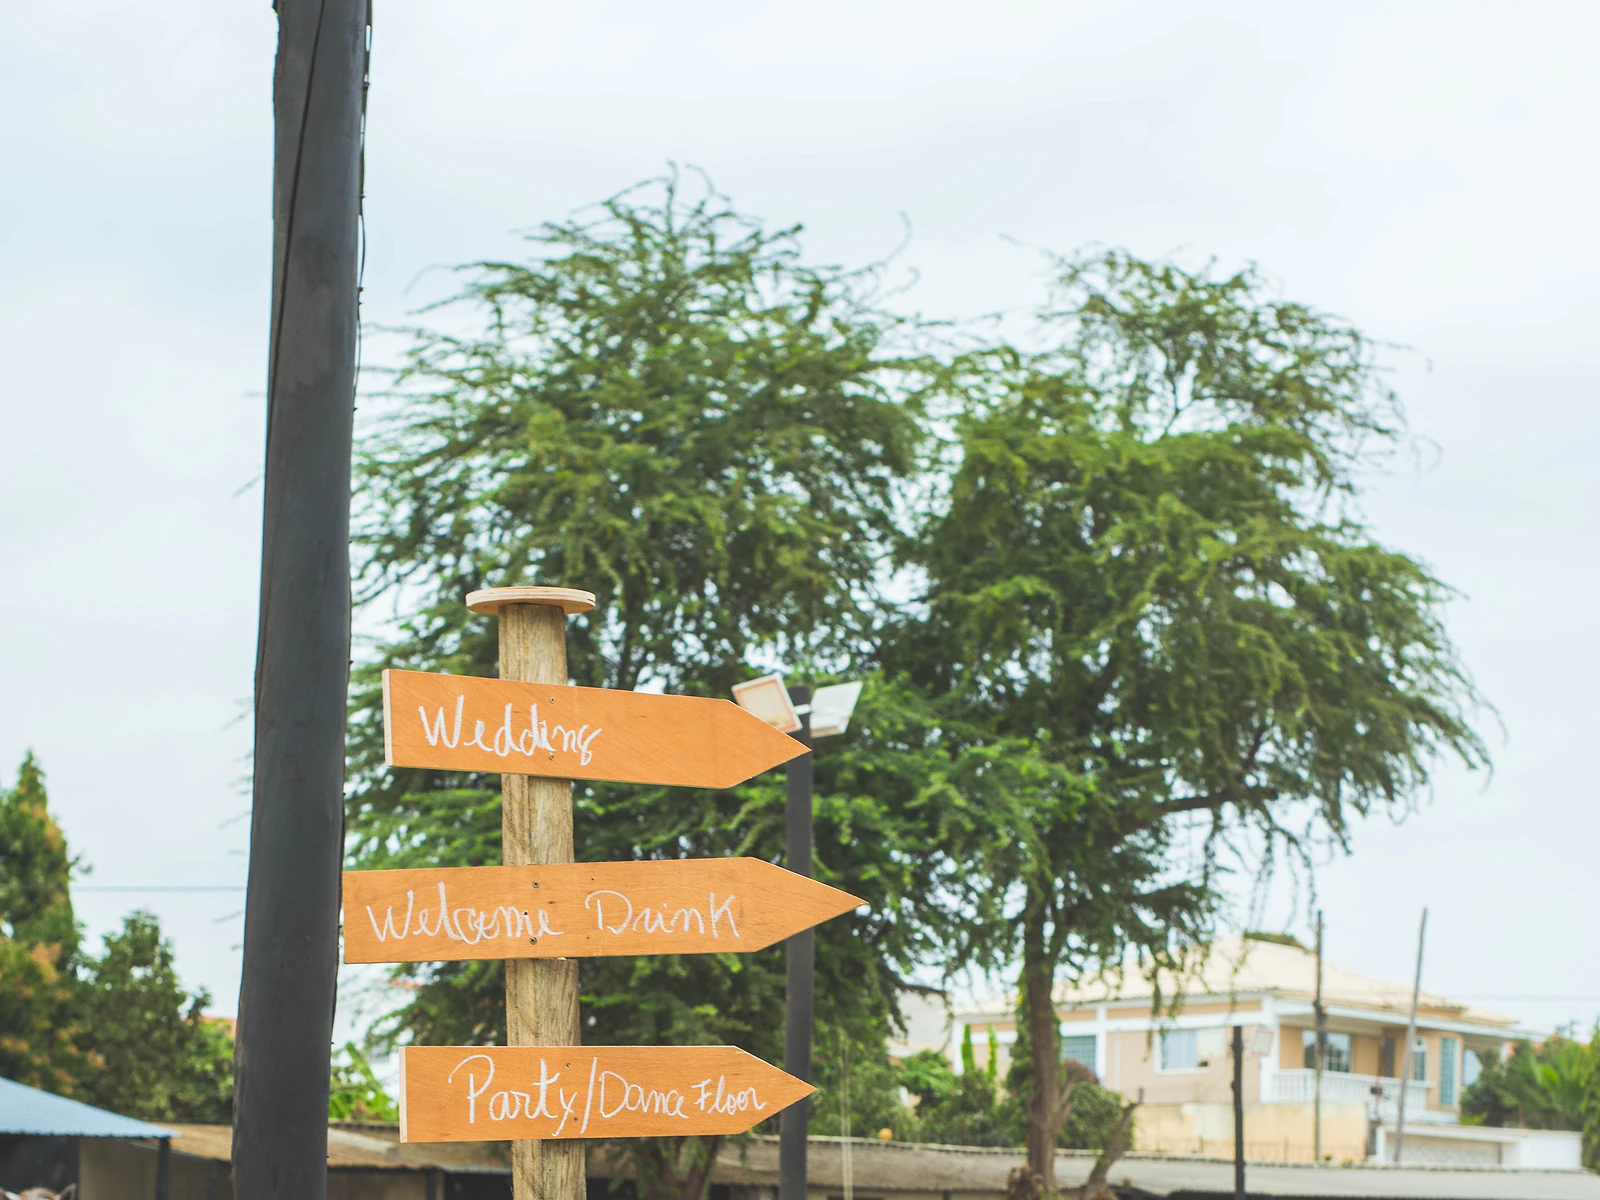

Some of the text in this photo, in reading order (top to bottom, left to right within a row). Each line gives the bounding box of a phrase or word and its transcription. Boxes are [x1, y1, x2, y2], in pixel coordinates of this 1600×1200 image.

[418, 694, 602, 766] Wedding
[366, 881, 741, 945] Welcome Drink
[690, 1075, 767, 1115] Floor
